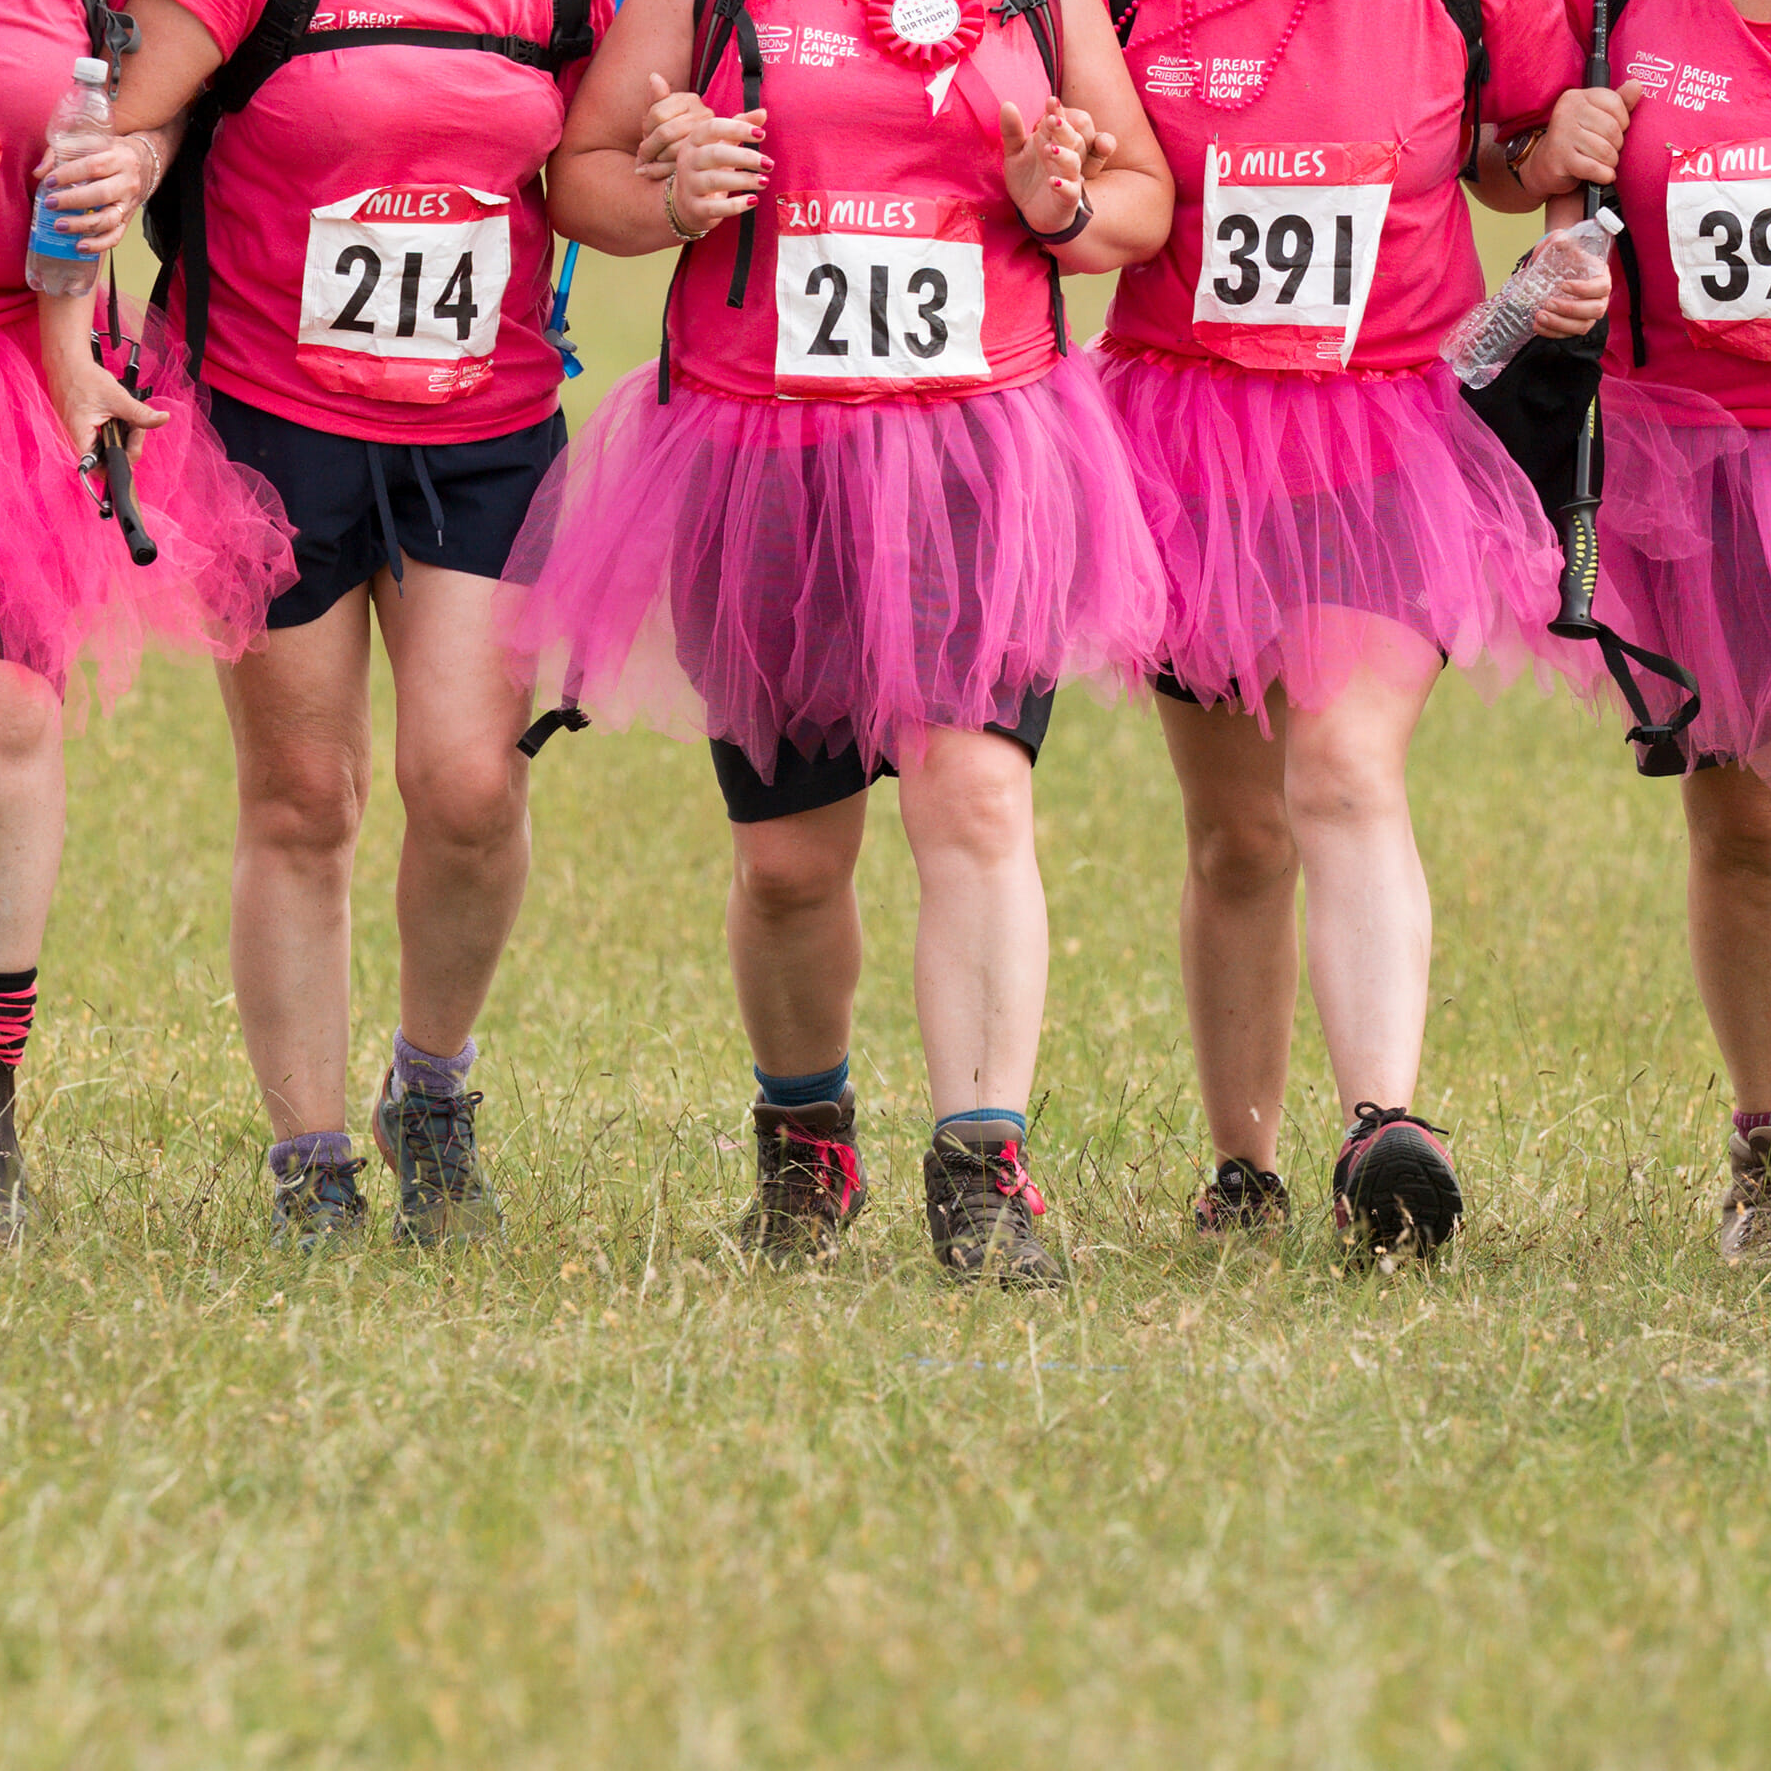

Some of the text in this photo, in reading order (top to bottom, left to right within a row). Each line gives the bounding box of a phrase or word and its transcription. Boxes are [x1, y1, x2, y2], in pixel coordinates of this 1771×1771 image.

[348, 10, 404, 25] BREAST
[902, 8, 923, 21] IT'S
[803, 27, 859, 46] BREAST
[801, 41, 861, 57] CANCER
[1635, 50, 1655, 64] PINK
[799, 53, 835, 67] NOW
[1158, 55, 1180, 66] PINK
[1212, 58, 1265, 72] BREAST
[1154, 70, 1193, 82] RIBBON
[1209, 72, 1263, 87] CANCER
[1631, 67, 1664, 83] RIBBON
[1682, 65, 1732, 89] BREAST
[1161, 87, 1191, 98] WALK
[1209, 86, 1242, 99] NOW
[1641, 87, 1659, 100] ALK
[1677, 80, 1730, 103] CANCER
[1673, 93, 1706, 112] NOW
[1240, 150, 1326, 178] MILES
[366, 192, 450, 217] MILES
[788, 199, 916, 229] 20 MILES
[1213, 214, 1353, 306] 391
[329, 244, 478, 341] 214
[805, 263, 949, 359] 213
